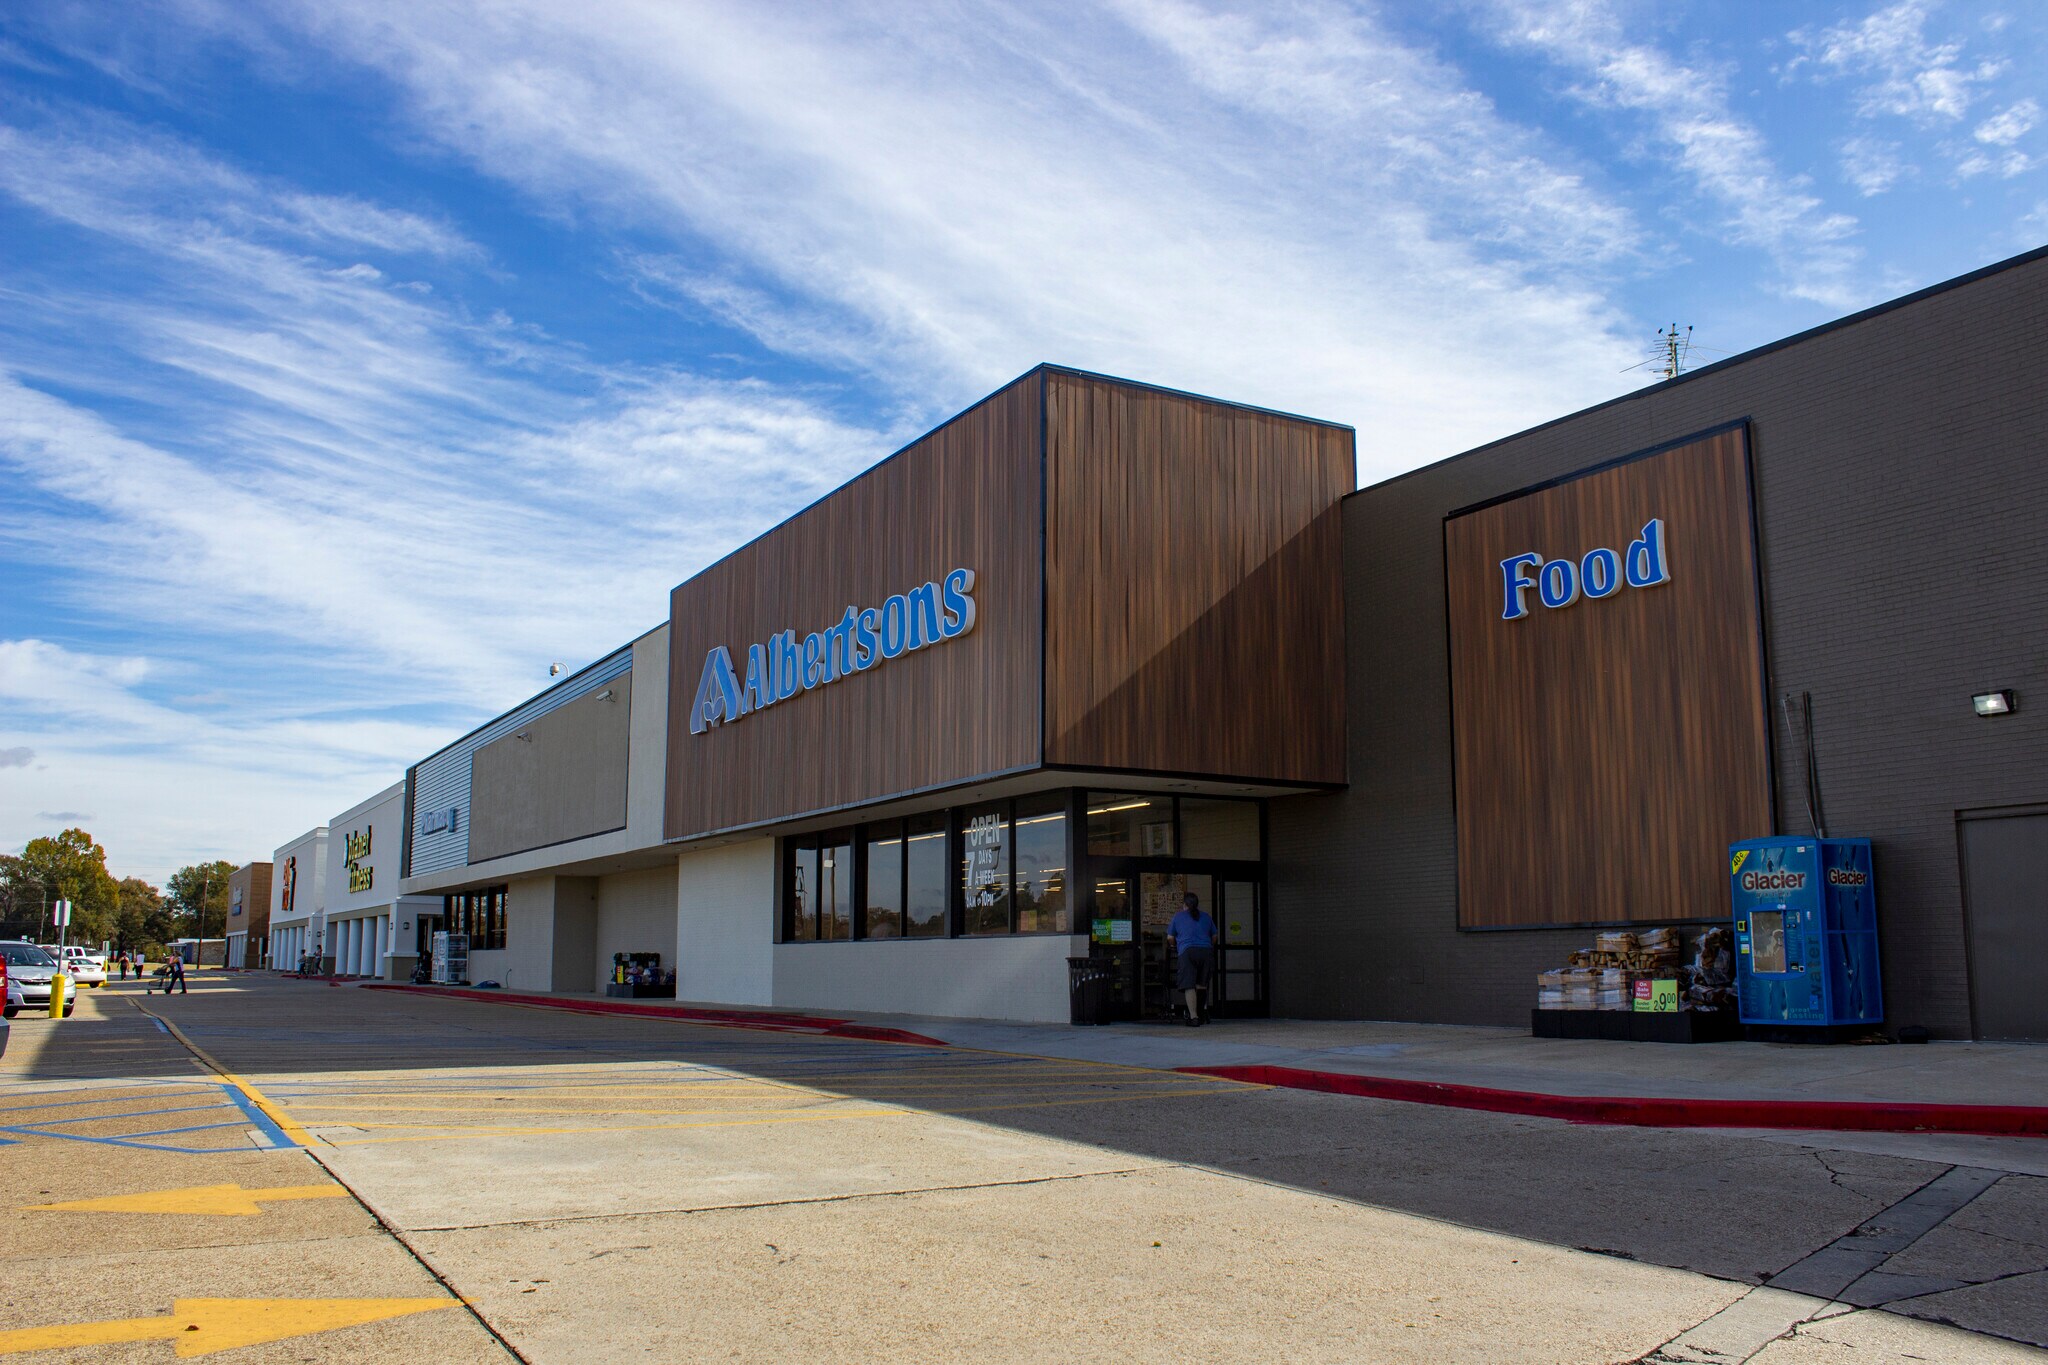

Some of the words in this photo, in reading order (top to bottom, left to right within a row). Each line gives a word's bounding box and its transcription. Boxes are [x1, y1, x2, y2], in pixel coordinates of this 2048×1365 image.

[1500, 518, 1671, 620] Food
[741, 568, 976, 715] Albertsons
[970, 813, 1000, 847] OPEN
[965, 851, 976, 886] 7
[978, 848, 993, 865] DAYS
[1742, 870, 1805, 890] Glacier
[1828, 868, 1867, 885] Glacier
